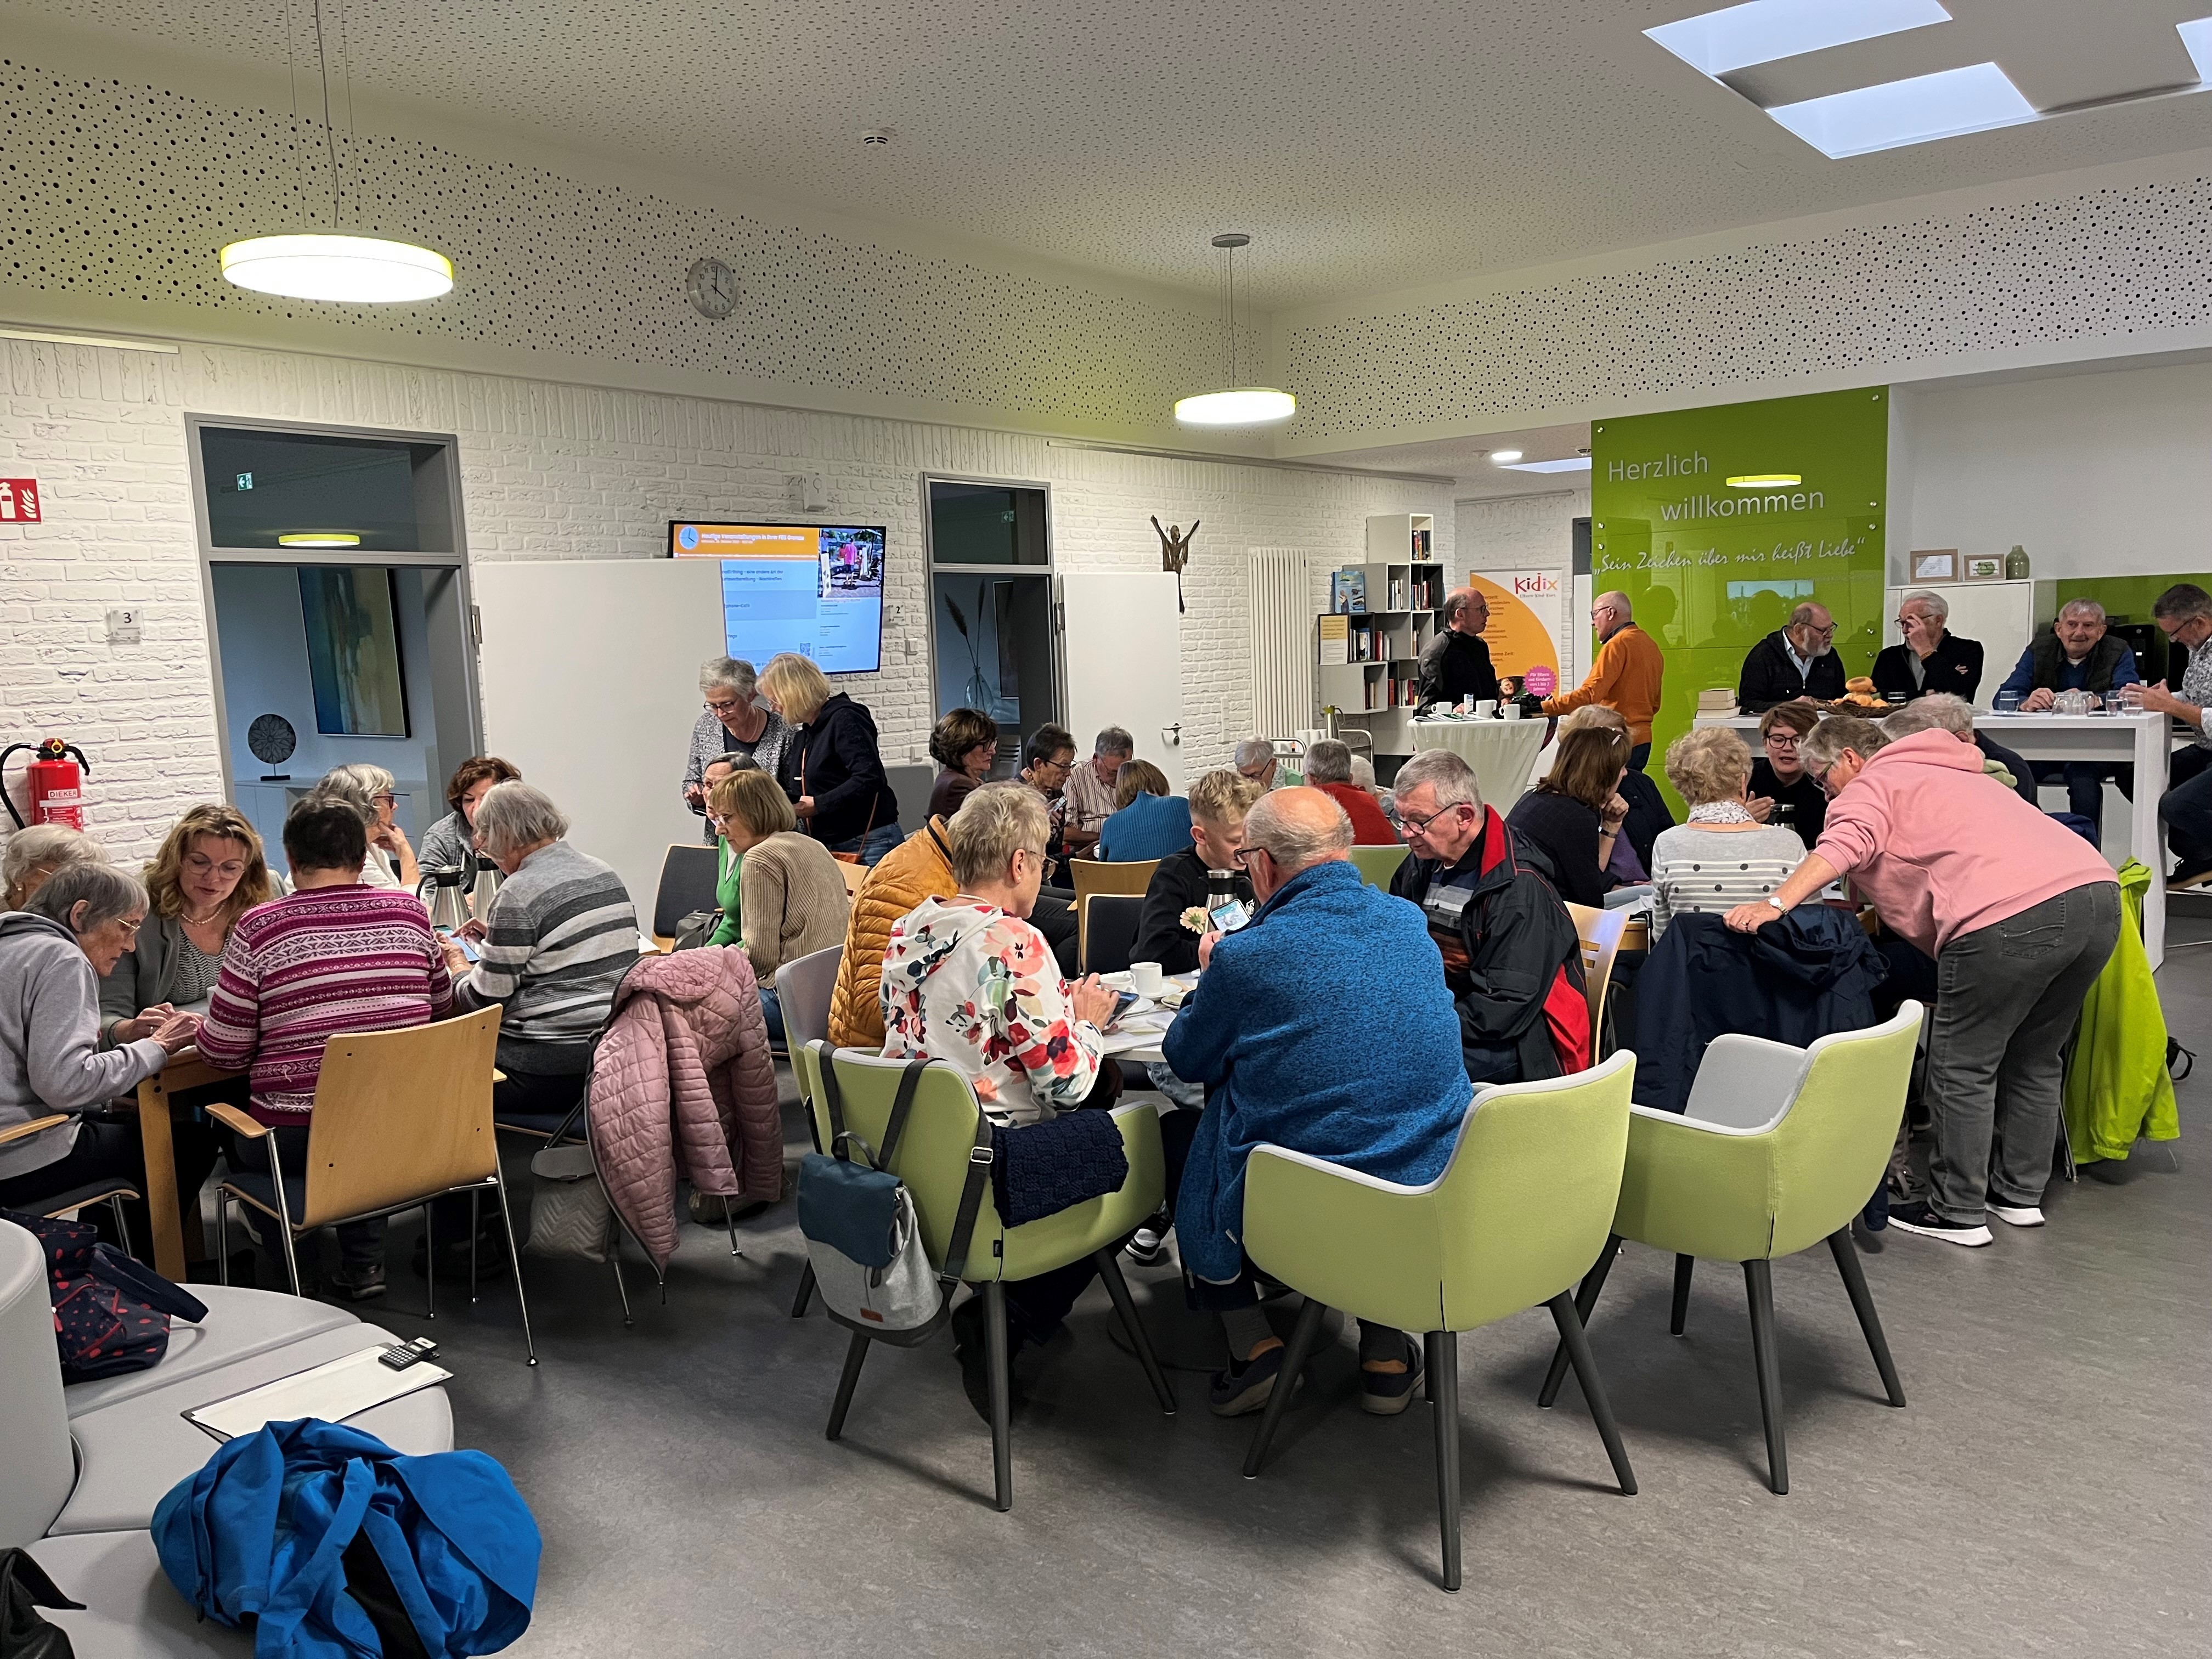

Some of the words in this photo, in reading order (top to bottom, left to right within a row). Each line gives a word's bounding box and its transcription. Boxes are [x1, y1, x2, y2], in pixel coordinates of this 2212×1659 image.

[1608, 450, 1708, 482] Herzlich
[1660, 491, 1824, 521] willkommen
[1636, 550, 1692, 569] Zeichen
[1698, 547, 1729, 566] über
[1735, 549, 1766, 562] mir
[1772, 541, 1812, 565] heißt
[123, 612, 132, 623] 3
[896, 606, 900, 614] 2
[43, 807, 48, 816] 1
